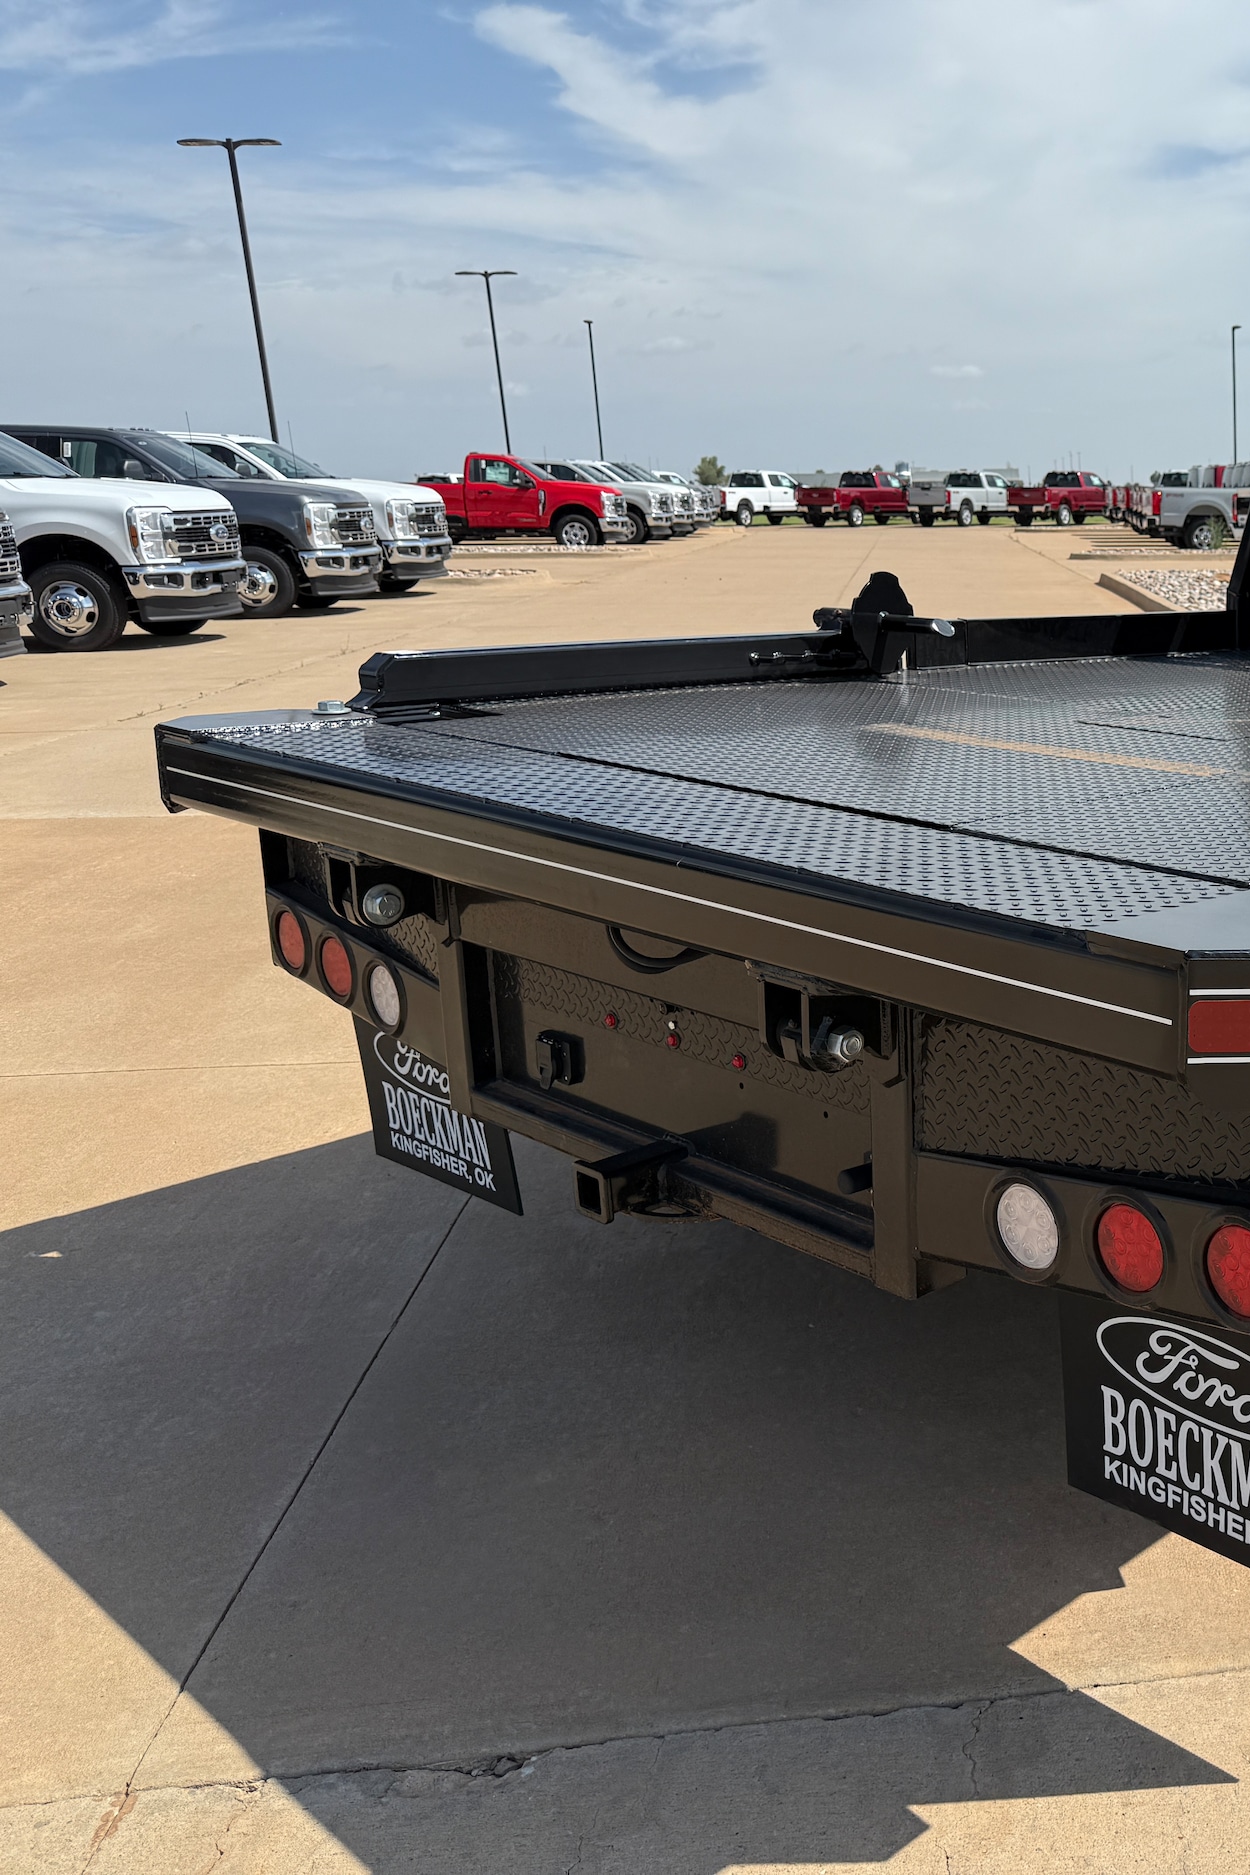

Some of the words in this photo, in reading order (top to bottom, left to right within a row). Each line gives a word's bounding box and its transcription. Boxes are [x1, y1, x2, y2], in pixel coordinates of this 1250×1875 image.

[382, 1080, 492, 1171] BOECKMAN
[390, 1130, 473, 1184] KINGFISHER,
[474, 1167, 497, 1192] OK
